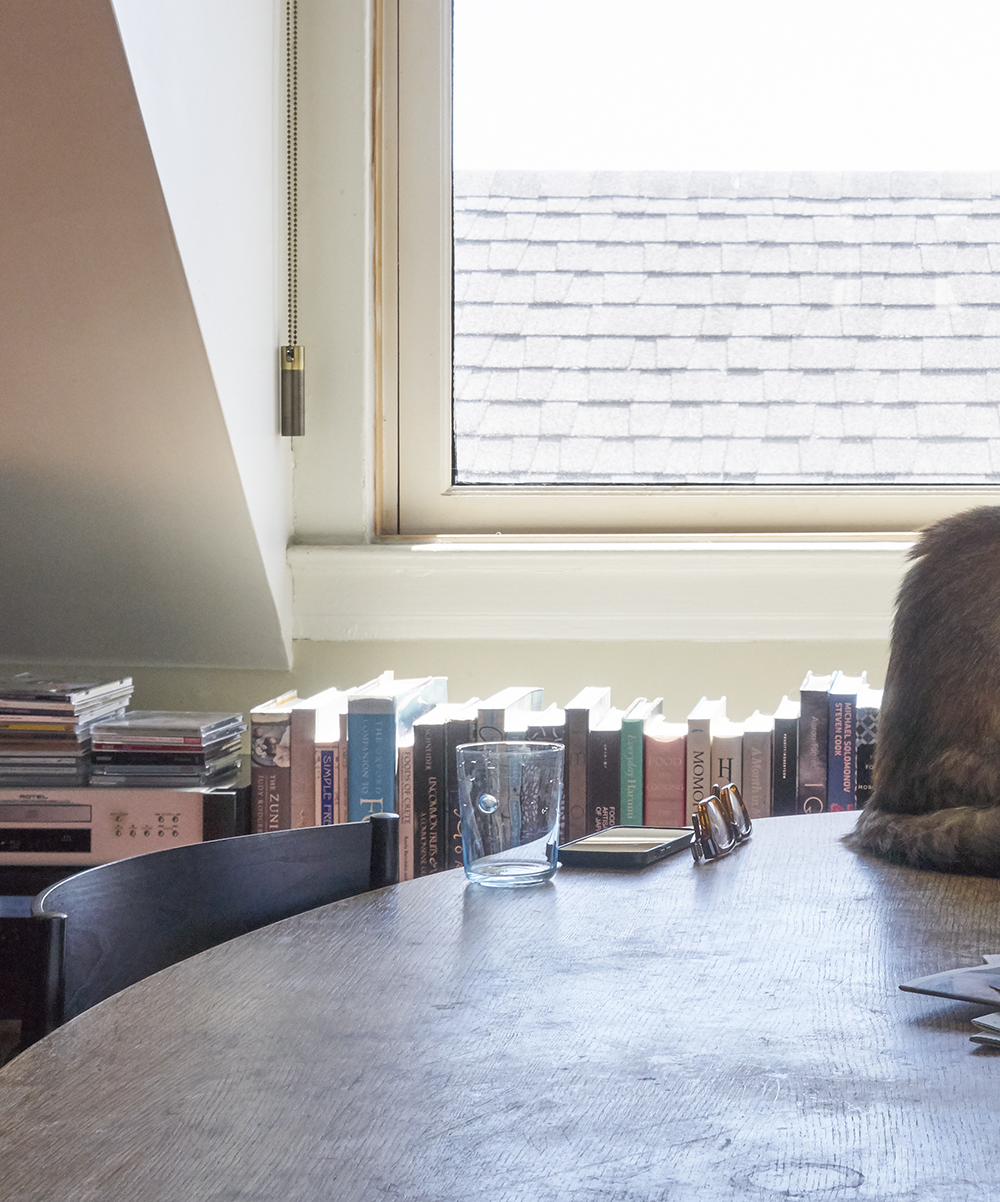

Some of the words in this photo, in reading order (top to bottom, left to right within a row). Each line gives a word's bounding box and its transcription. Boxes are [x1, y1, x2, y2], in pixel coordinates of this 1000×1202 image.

[834, 702, 843, 733] STEVEN
[843, 702, 852, 739] MICHAEL
[624, 734, 636, 777] Everyday
[751, 747, 764, 756] A
[834, 734, 842, 756] COOK
[648, 757, 682, 766] FOOD
[751, 758, 763, 793] Month
[843, 741, 852, 793] SOLOMONOV
[322, 755, 332, 800] SIMPLE
[361, 782, 369, 794] TO
[404, 783, 411, 796] OF
[269, 793, 280, 829] ZUNI
[595, 806, 601, 816] OF
[626, 779, 637, 819] Harumi
[751, 795, 761, 806] in
